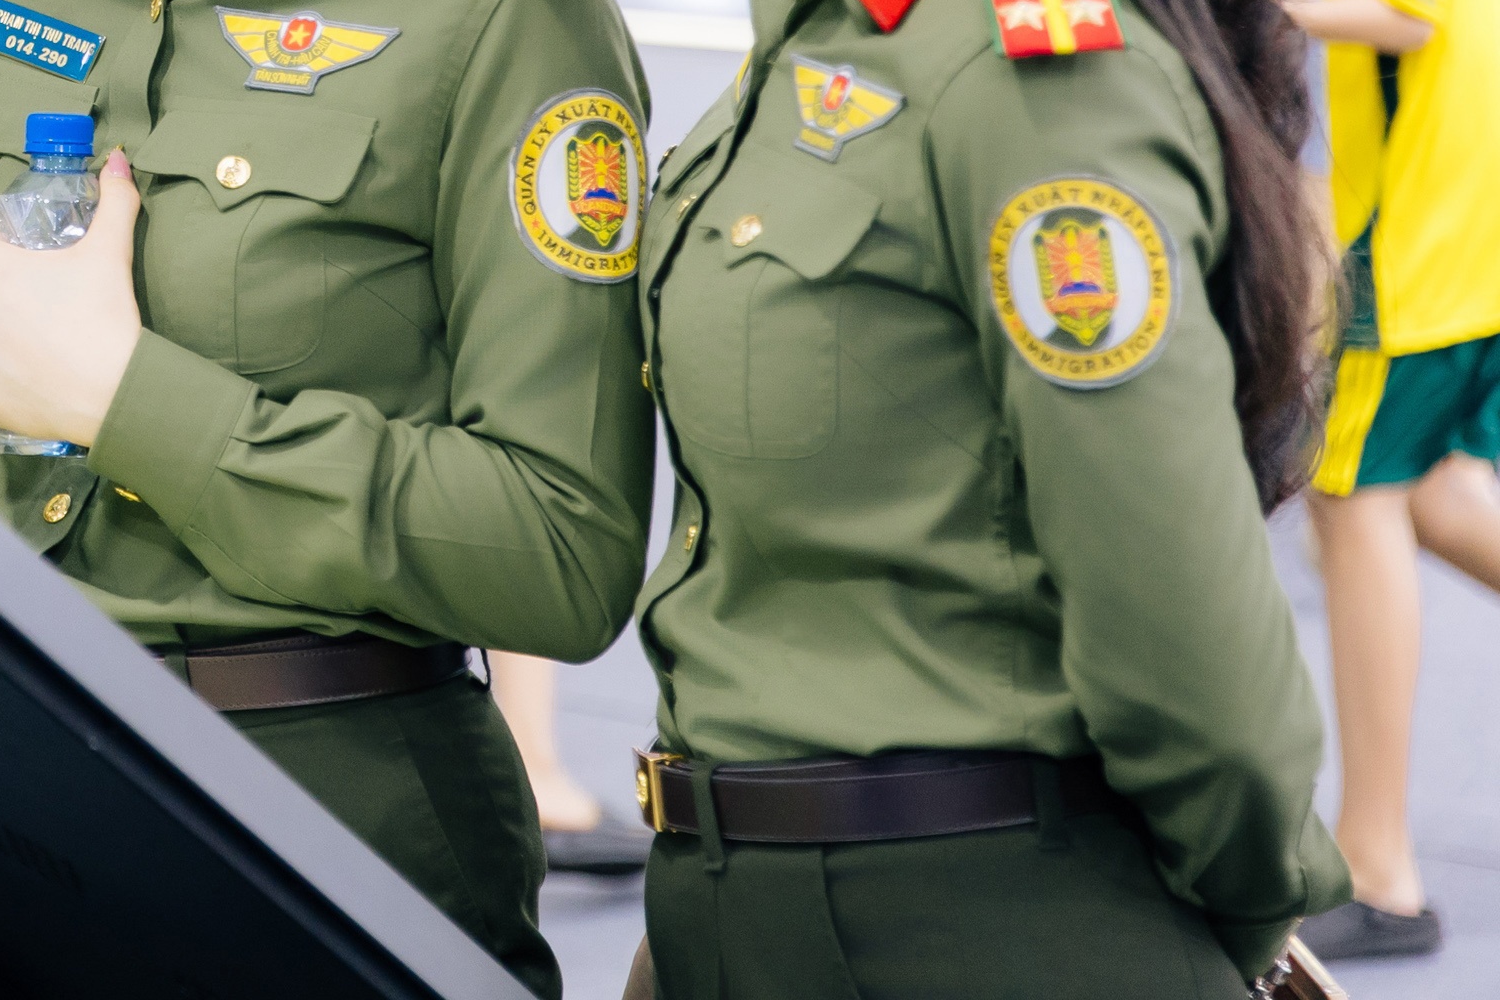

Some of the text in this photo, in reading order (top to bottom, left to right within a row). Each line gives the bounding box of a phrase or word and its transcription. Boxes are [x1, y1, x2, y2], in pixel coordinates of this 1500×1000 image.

[24, 19, 42, 40] THỊ
[41, 26, 63, 44] THU
[62, 34, 96, 55] TRANG
[555, 99, 611, 125] XUẤT
